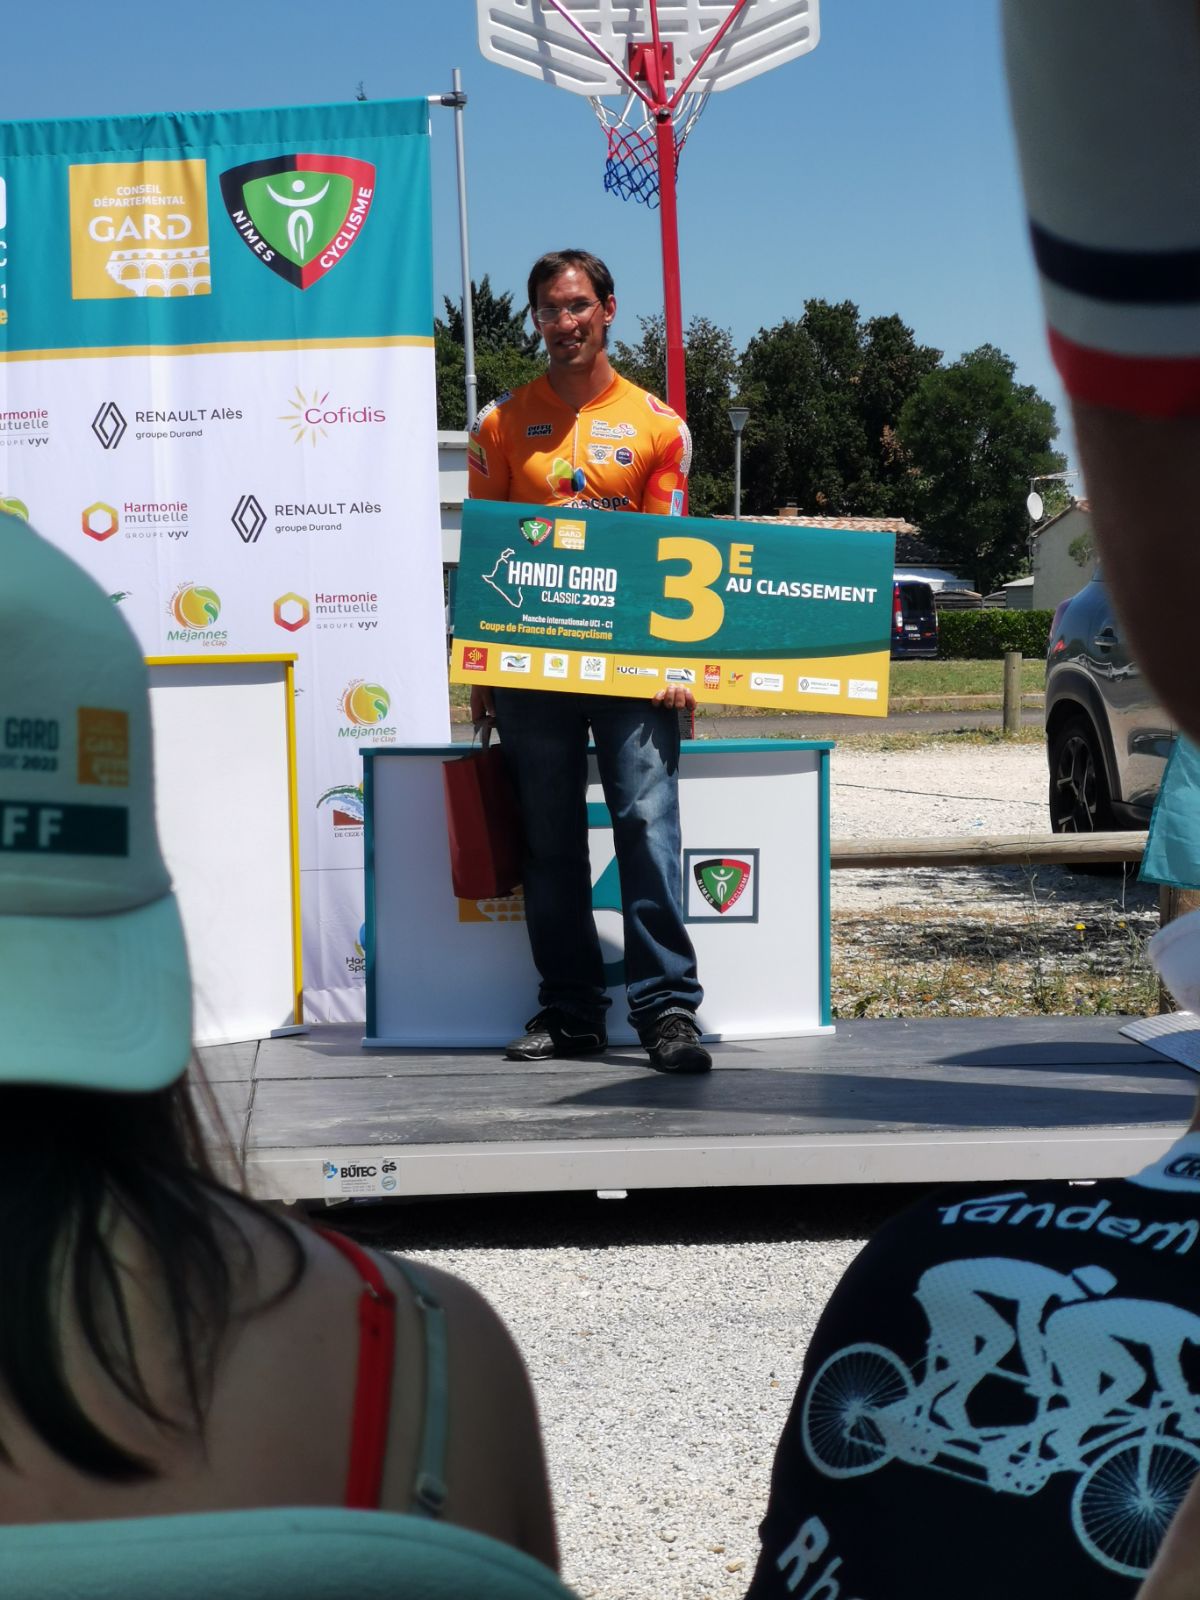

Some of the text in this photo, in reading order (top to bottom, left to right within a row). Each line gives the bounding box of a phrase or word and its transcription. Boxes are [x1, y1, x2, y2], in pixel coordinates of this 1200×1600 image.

[116, 184, 162, 196] CONSEIL
[93, 195, 186, 208] DÉPARTEMENTAL
[88, 213, 192, 243] GARD
[320, 186, 373, 269] CYCLISME
[232, 209, 275, 262] NÎMES
[0, 409, 48, 420] rmonie
[135, 407, 243, 422] RENAULT Alès
[304, 406, 386, 424] Cofidis
[0, 419, 48, 430] utuelle
[135, 429, 203, 440] groupe Durand
[28, 437, 49, 447] vyv
[124, 501, 188, 512] Harmonie
[275, 501, 382, 516] RENAULT Alès
[125, 511, 188, 523] mutuelle
[168, 530, 188, 541] vyv
[275, 523, 342, 534] groupe Durand
[508, 560, 618, 592] HANDI GARD
[315, 592, 378, 603] Harmonie
[726, 577, 878, 604] AU CLASSEMENT
[541, 591, 615, 607] CLASSIC 2023
[316, 602, 378, 614] mutuelle
[358, 621, 378, 631] vyv
[522, 614, 546, 623] Manche
[589, 619, 600, 627] UCI
[605, 620, 613, 629] C1
[167, 629, 228, 643] Méjannes
[480, 620, 613, 640] Coupe de France de Paracyclisme
[620, 666, 638, 674] UCI
[4, 717, 60, 752] GARD
[337, 726, 397, 740] Méjannes
[937, 1191, 1200, 1255] Tandem
